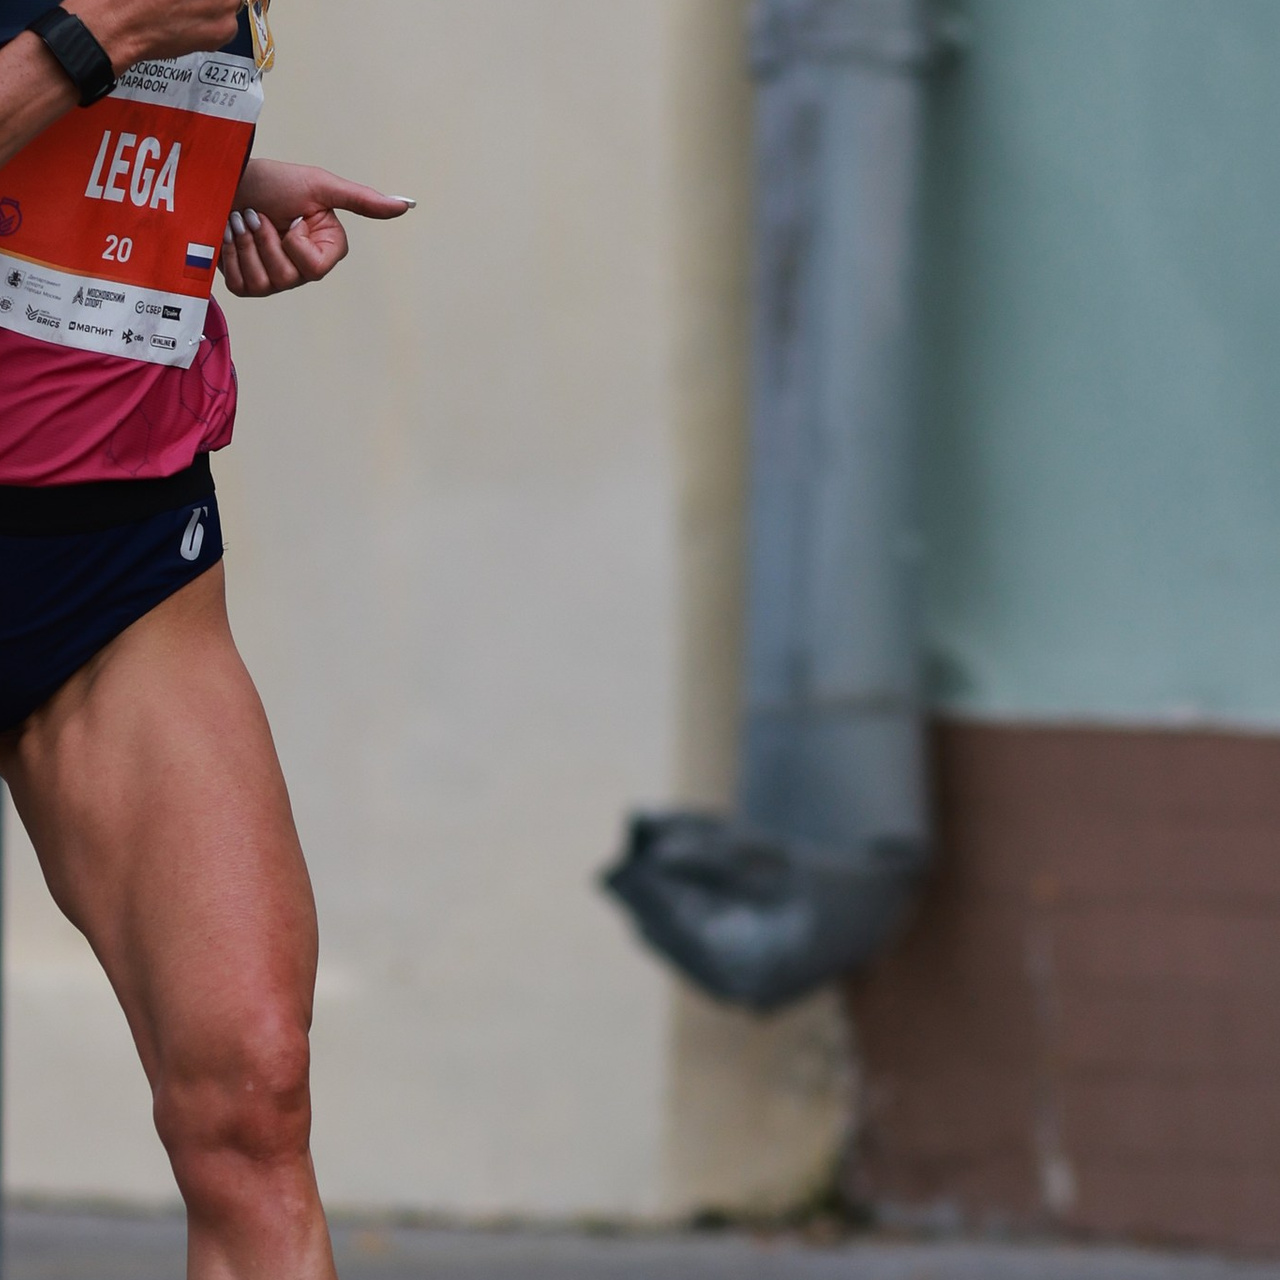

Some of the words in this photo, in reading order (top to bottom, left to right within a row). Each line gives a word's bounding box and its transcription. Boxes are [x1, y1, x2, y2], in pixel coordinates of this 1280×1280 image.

[128, 61, 192, 83] ОСКОВСКИЙ
[205, 65, 228, 82] 42,2
[230, 70, 246, 86] КМ
[84, 129, 182, 213] LEGA
[101, 234, 133, 263] 20
[36, 316, 60, 329] BRICS
